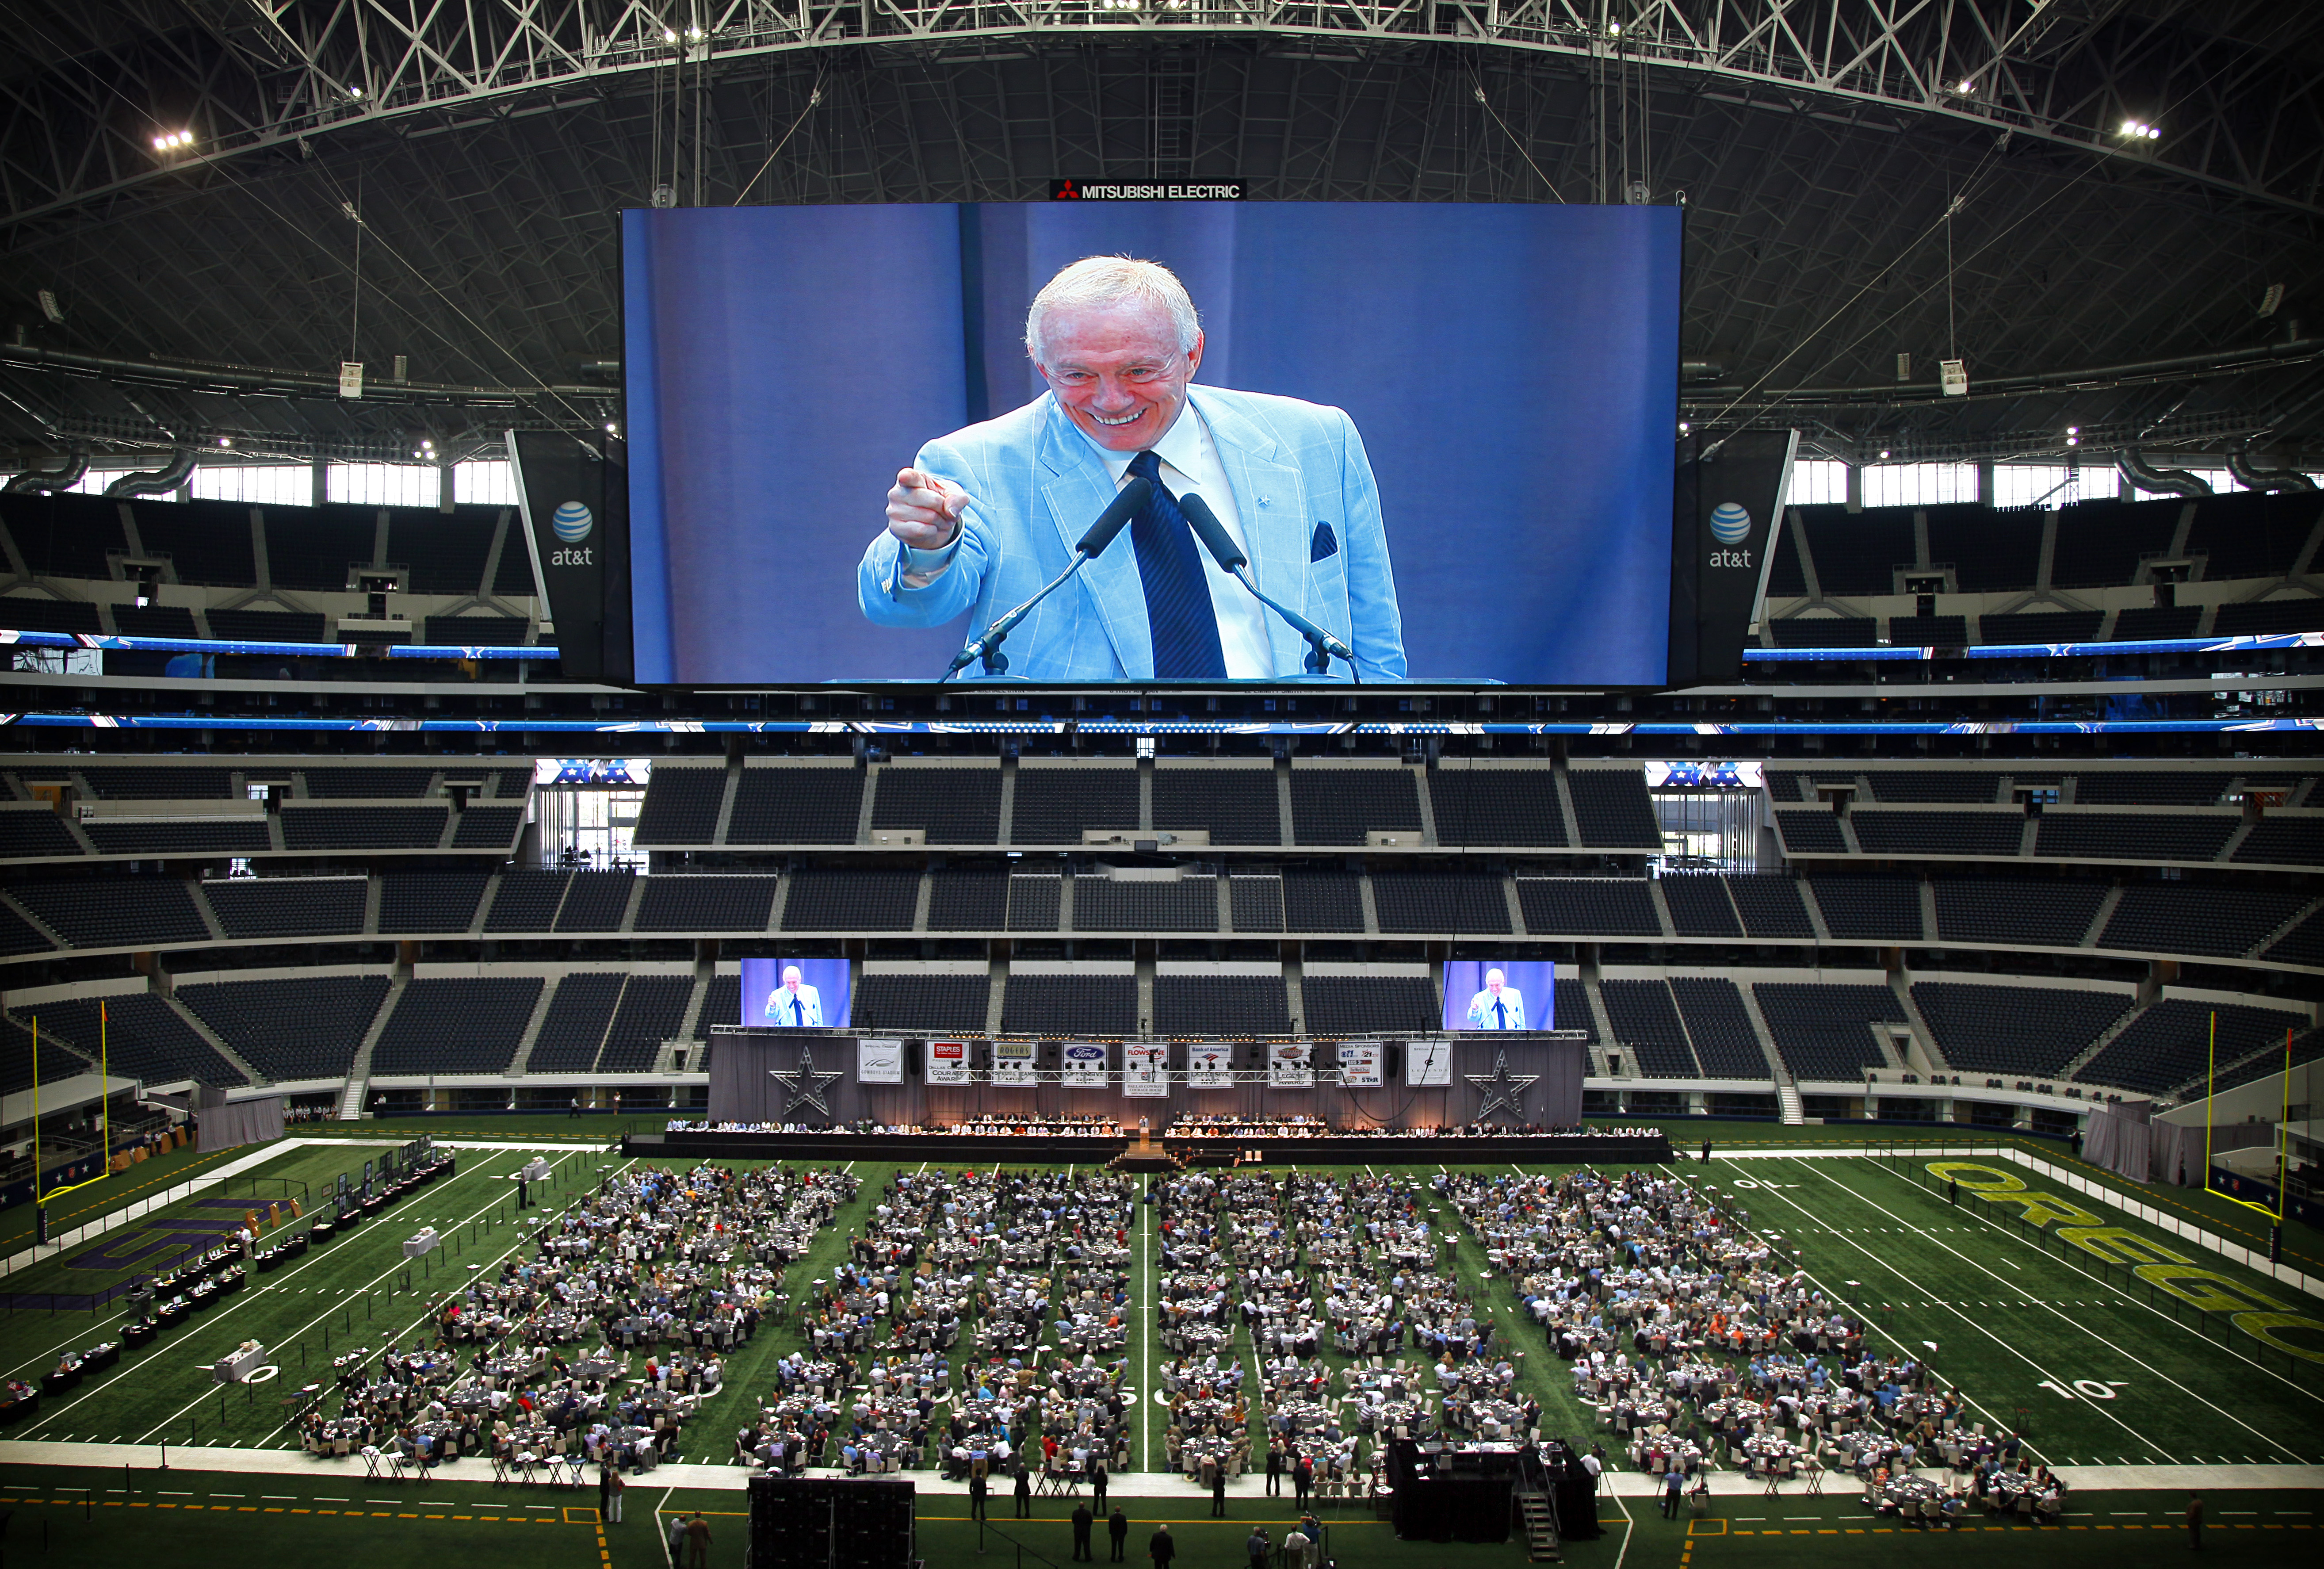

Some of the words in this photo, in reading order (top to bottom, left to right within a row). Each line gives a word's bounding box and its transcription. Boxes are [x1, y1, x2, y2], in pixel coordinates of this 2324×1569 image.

[1082, 185, 1164, 198] MITSUBISHI
[1169, 185, 1240, 198] ELECTRIC
[552, 547, 592, 566] at&t
[1709, 549, 1751, 568] at&t
[1074, 1048, 1097, 1058] Ford
